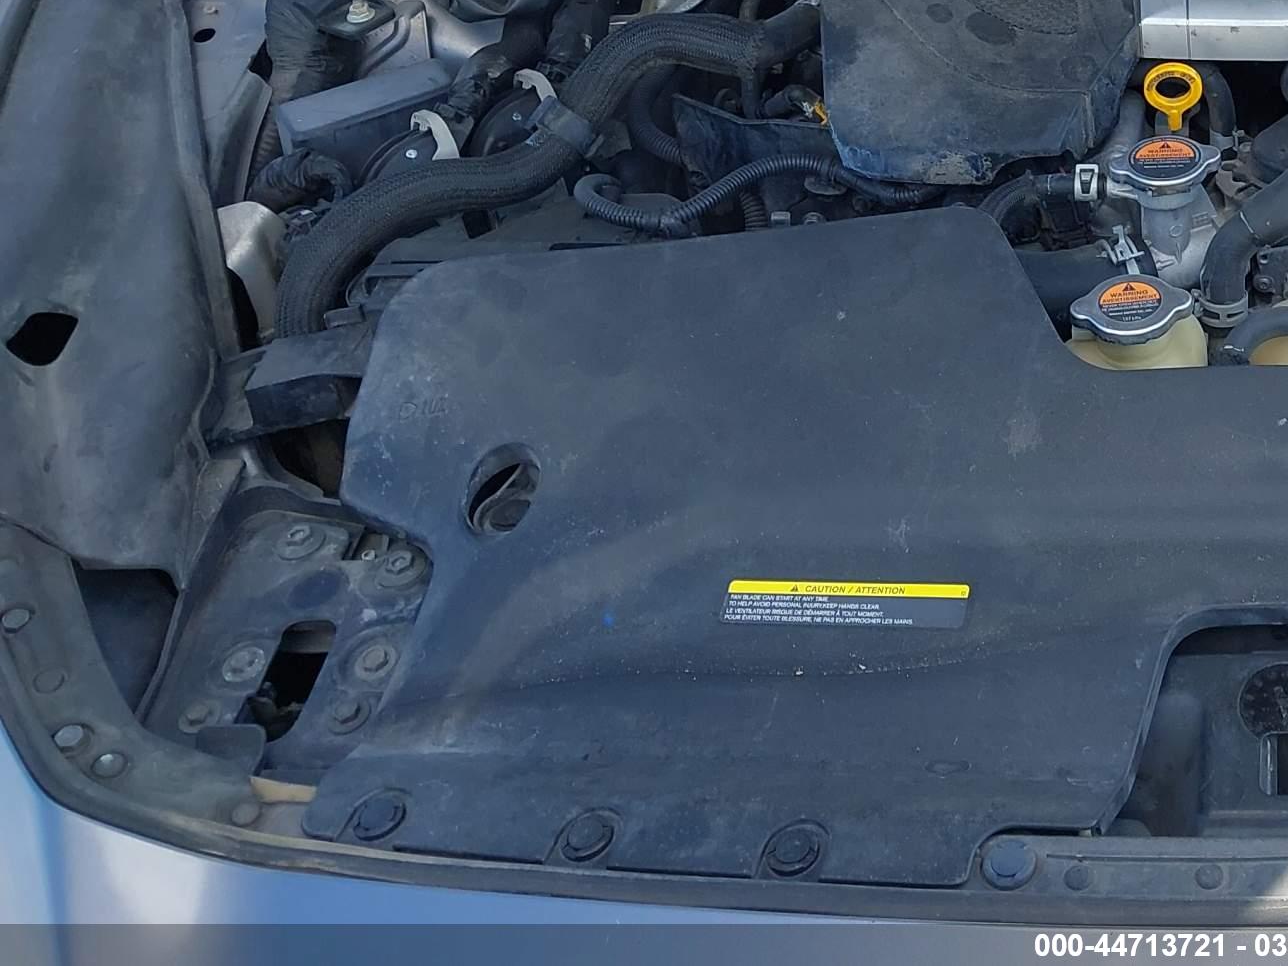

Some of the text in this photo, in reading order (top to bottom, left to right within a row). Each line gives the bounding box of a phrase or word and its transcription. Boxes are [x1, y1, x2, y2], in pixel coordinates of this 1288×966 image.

[1110, 290, 1149, 298] WARNING
[805, 585, 846, 593] CAUTION
[855, 586, 906, 594] ATTENTION
